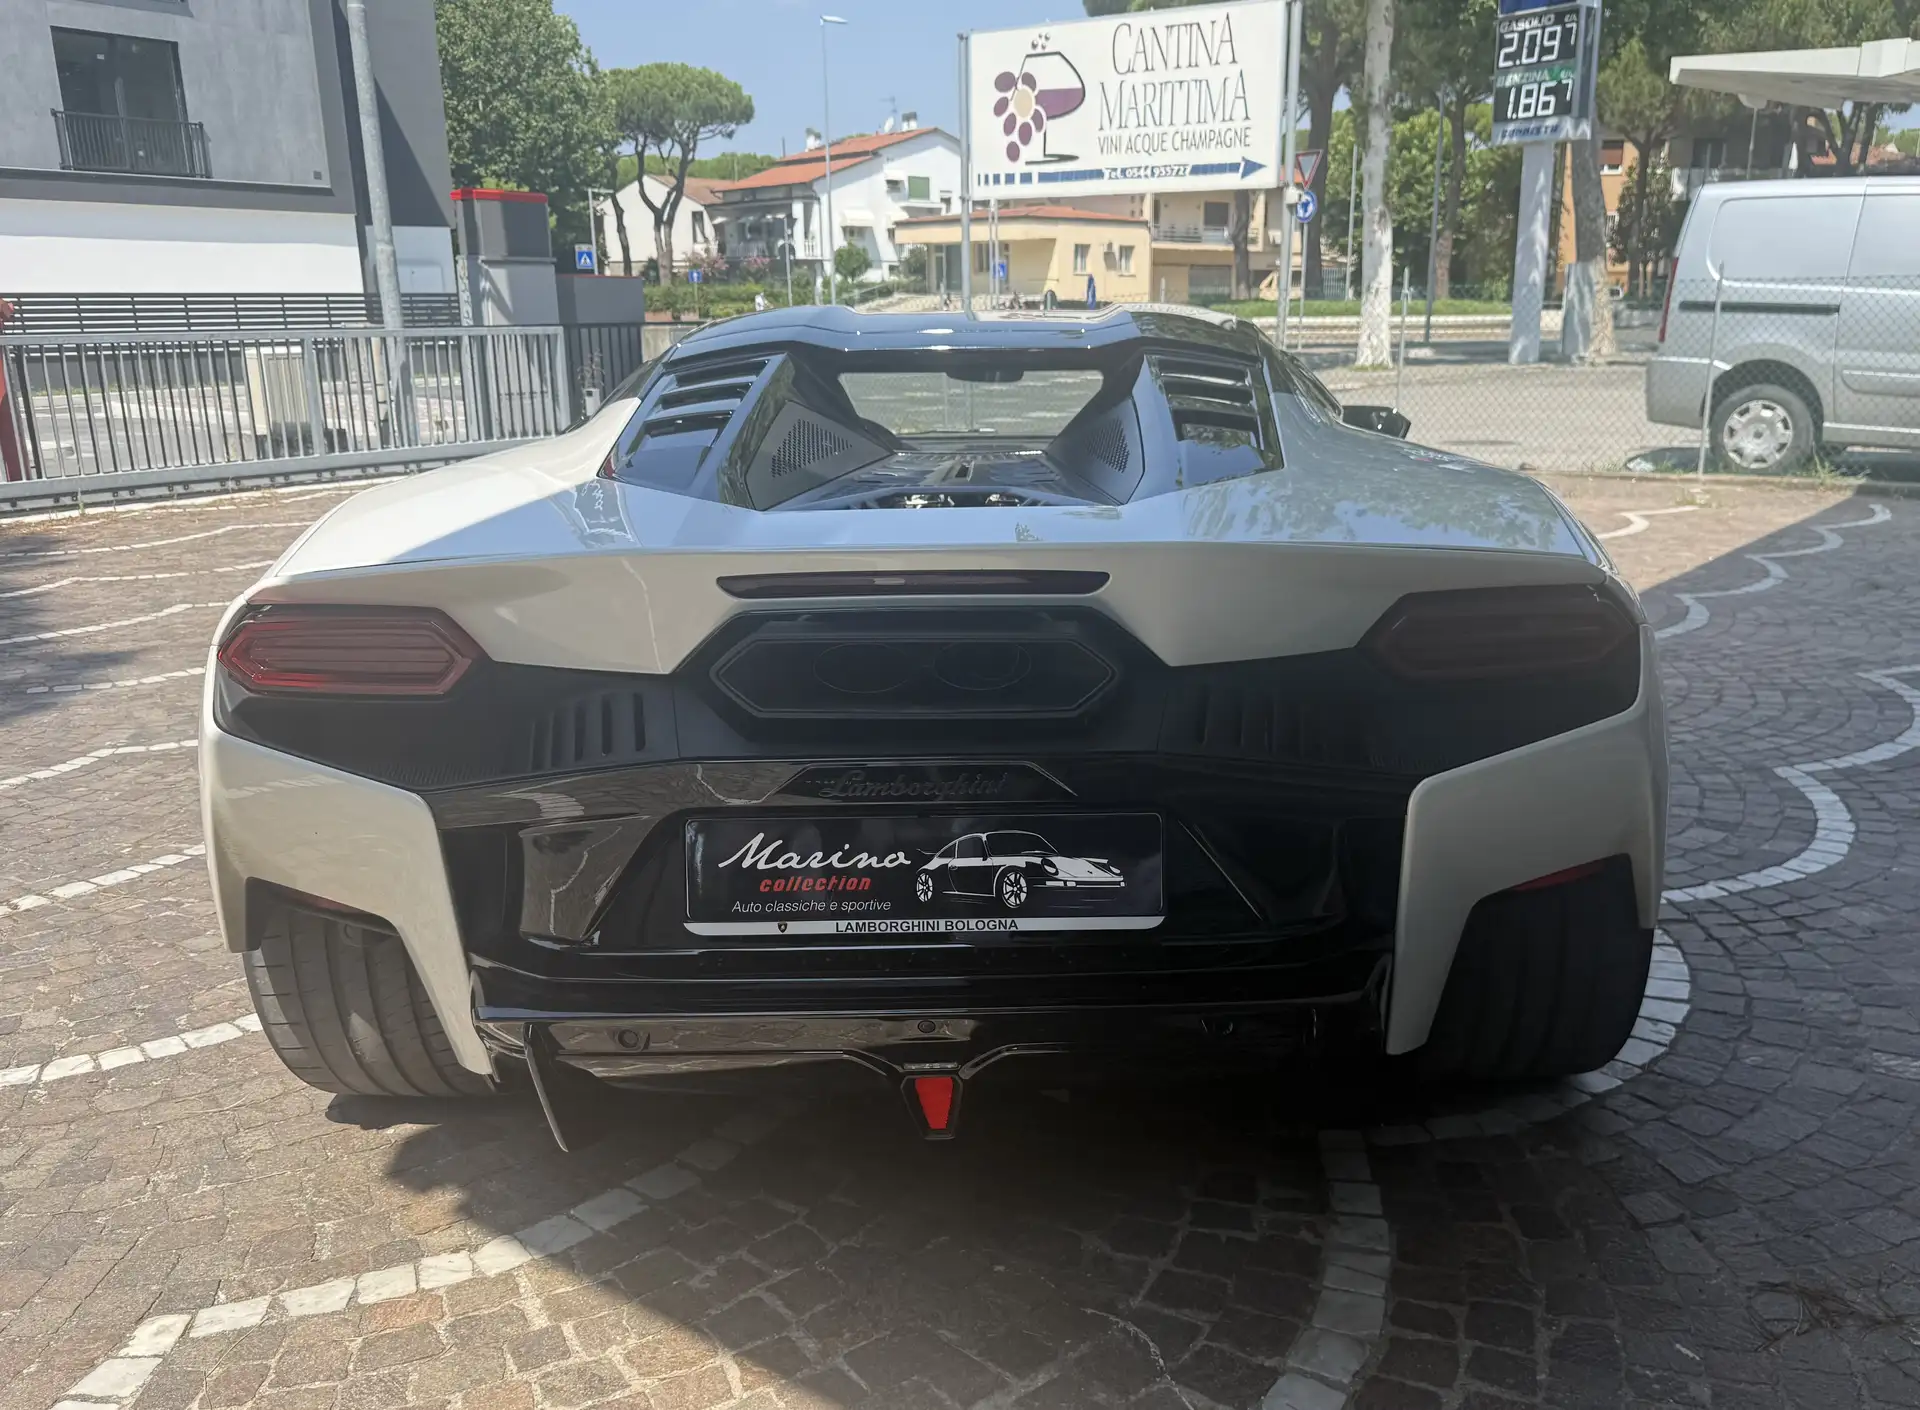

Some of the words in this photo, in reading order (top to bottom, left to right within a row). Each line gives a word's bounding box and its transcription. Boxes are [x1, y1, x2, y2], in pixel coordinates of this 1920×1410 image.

[1112, 12, 1238, 75] CANTINA
[1098, 68, 1251, 131] MARITTIMA
[1098, 135, 1122, 156] VINI
[1124, 132, 1168, 157] ACQUE
[1172, 127, 1251, 151] CHAMPAGNE
[819, 769, 1008, 799] Lamborghini
[718, 832, 911, 870] Marino
[760, 875, 871, 892] collection
[732, 901, 761, 913] Auto
[765, 899, 826, 913] classiche
[830, 902, 838, 911] e
[842, 899, 891, 915] sportive
[835, 921, 940, 933] LAMBORGHINI
[944, 919, 1019, 931] BOLOGNA
